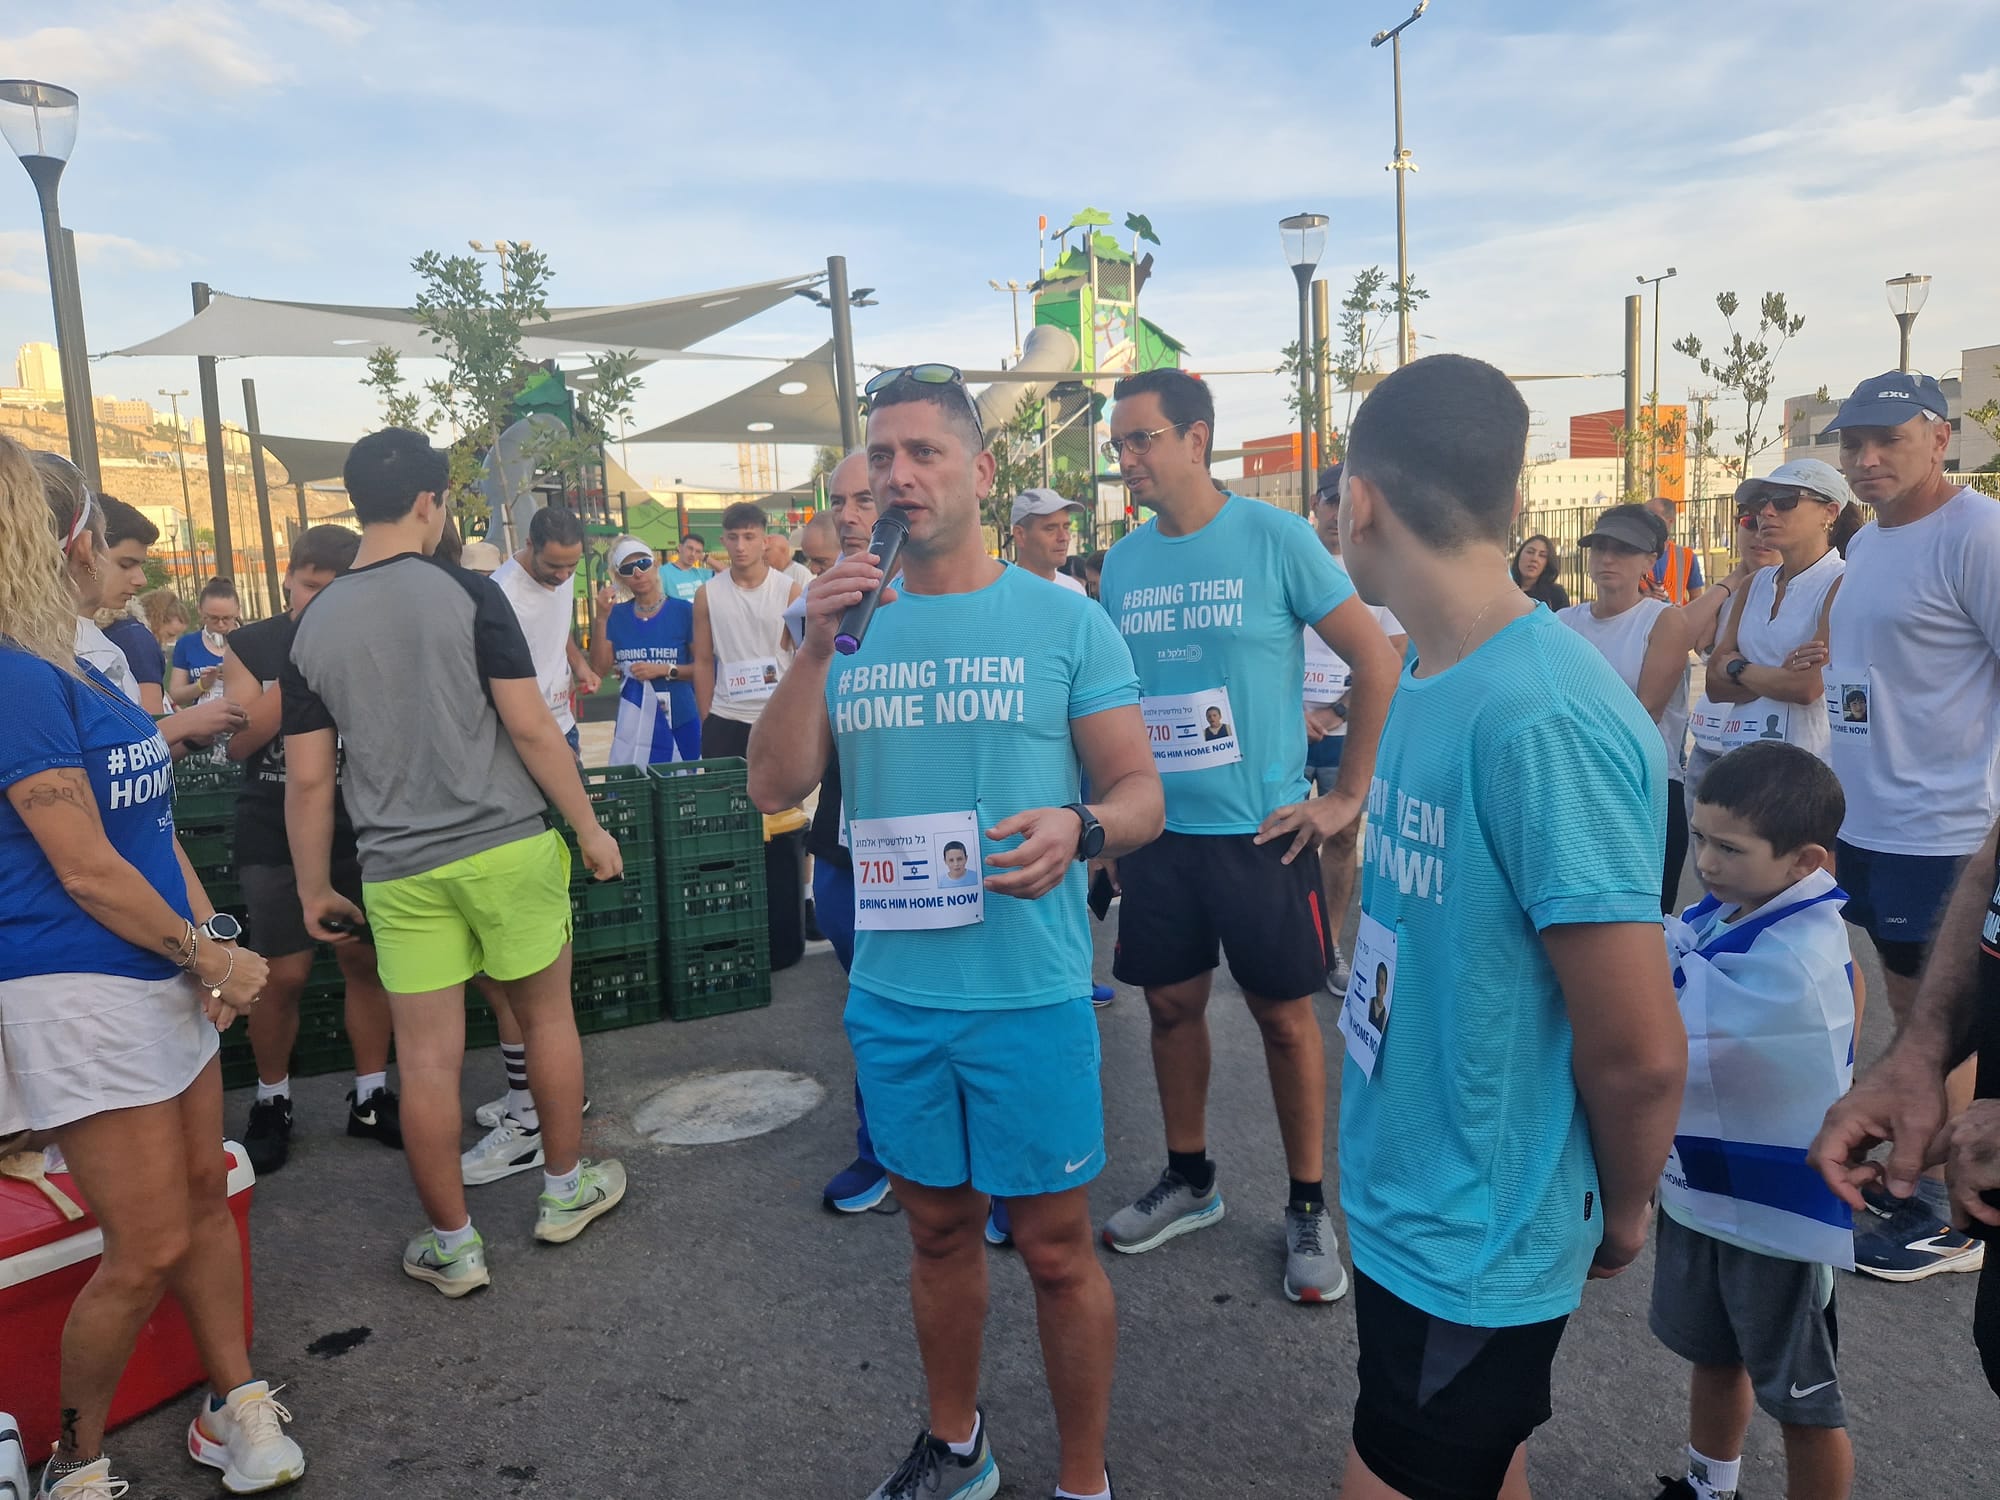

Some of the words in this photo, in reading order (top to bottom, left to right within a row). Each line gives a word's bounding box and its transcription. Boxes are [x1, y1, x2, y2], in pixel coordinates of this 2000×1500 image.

[1122, 583, 1184, 610] #BRING
[1189, 578, 1243, 601] THEM
[1120, 609, 1176, 635] HOME
[1183, 603, 1243, 630] NOW!
[616, 647, 648, 660] #BRING
[650, 647, 678, 659] THEM
[729, 676, 746, 687] 7.10
[838, 660, 937, 696] #BRING
[944, 656, 1025, 684] THEM
[1304, 671, 1324, 683] 7.10
[836, 695, 925, 734] HOME
[935, 689, 1024, 724] NOW!
[1146, 725, 1170, 741] 7.10
[1723, 720, 1740, 733] 7.10
[1849, 726, 1868, 735] NOW
[1153, 750, 1166, 759] ING
[1167, 749, 1183, 758] HIM
[1184, 746, 1211, 757] HOME
[1212, 741, 1234, 752] NOW
[110, 761, 172, 810] HOM
[860, 860, 895, 884] 7.10
[860, 898, 888, 910] BRING
[889, 898, 908, 909] HIM
[909, 896, 944, 908] HOME
[947, 892, 979, 906] NOW
